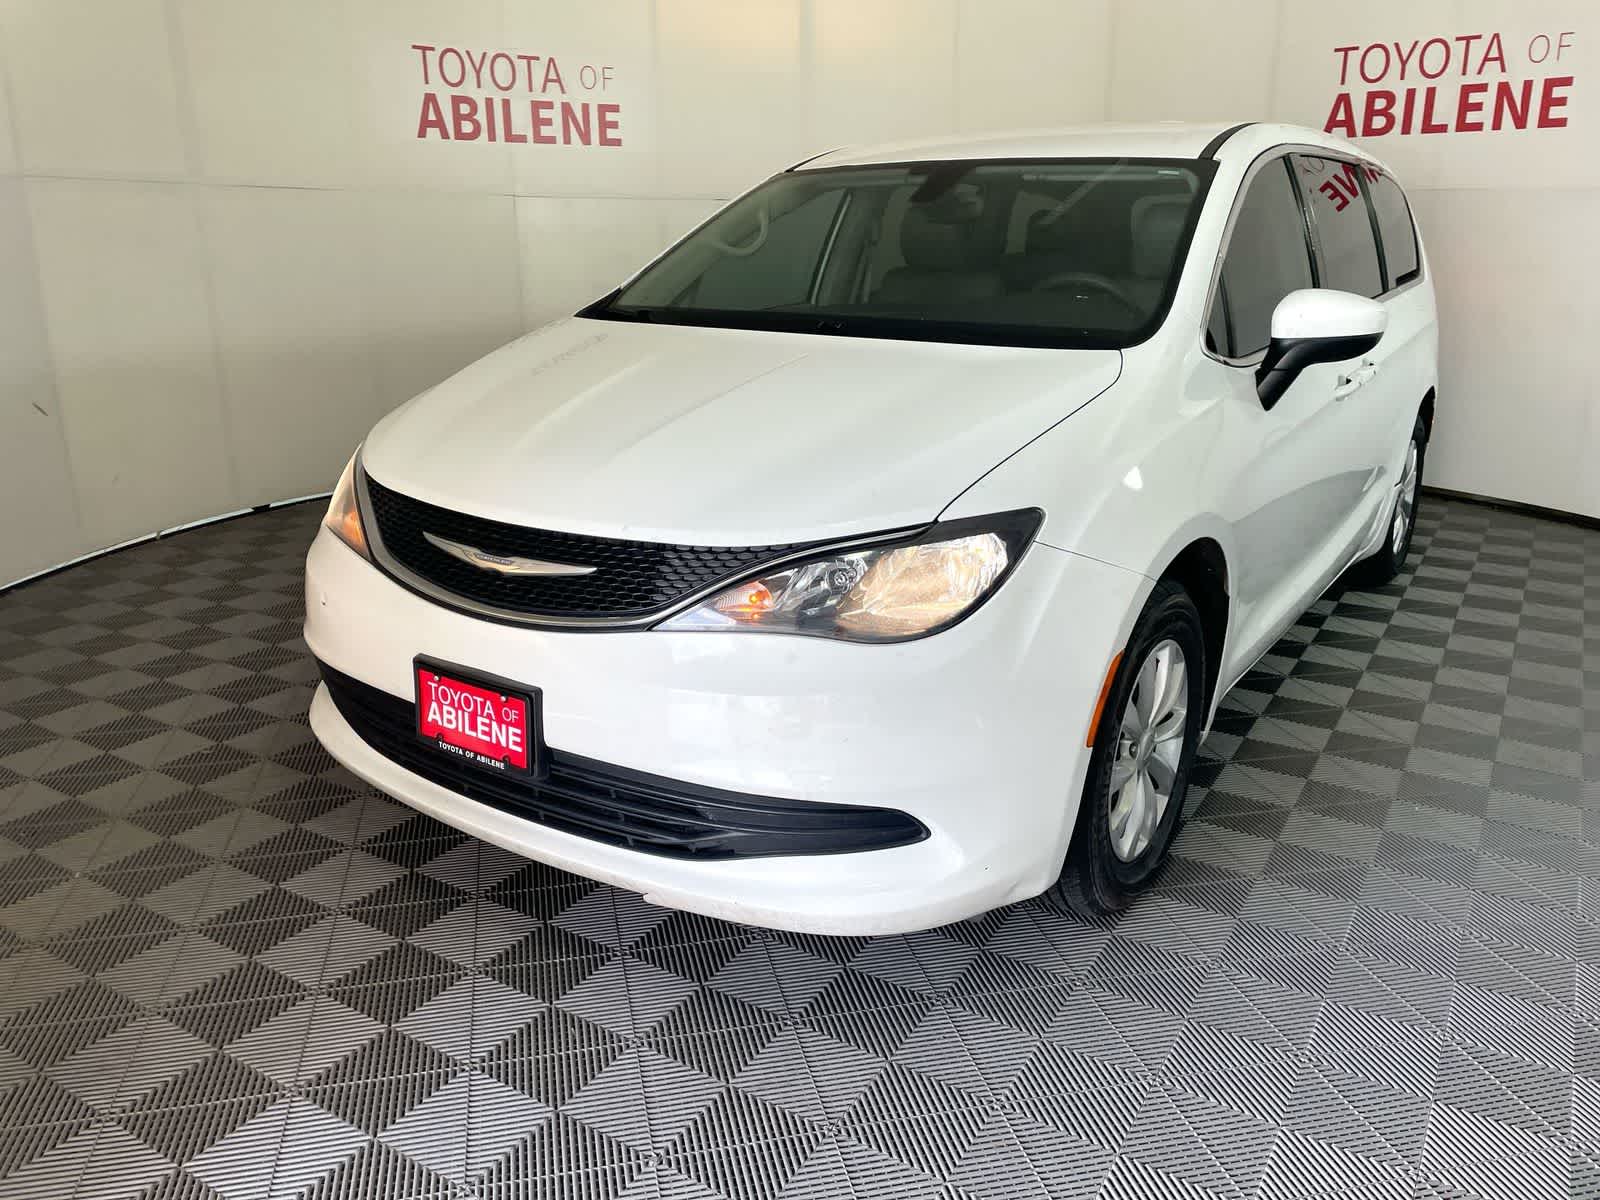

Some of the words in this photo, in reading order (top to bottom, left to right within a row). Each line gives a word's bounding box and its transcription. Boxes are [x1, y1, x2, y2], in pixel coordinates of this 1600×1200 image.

[411, 44, 566, 94] TOYOTA
[580, 65, 614, 91] OF
[1333, 32, 1507, 86] TOYOTA
[1528, 31, 1575, 64] OF
[416, 92, 623, 147] ABILENE
[1323, 76, 1574, 138] ABILENE
[427, 681, 496, 720] TOYOTA
[501, 707, 519, 723] OF
[427, 701, 523, 753] ABILENE
[438, 741, 464, 755] TOYOTA
[465, 750, 475, 759] OF
[476, 755, 505, 770] ABILENE
